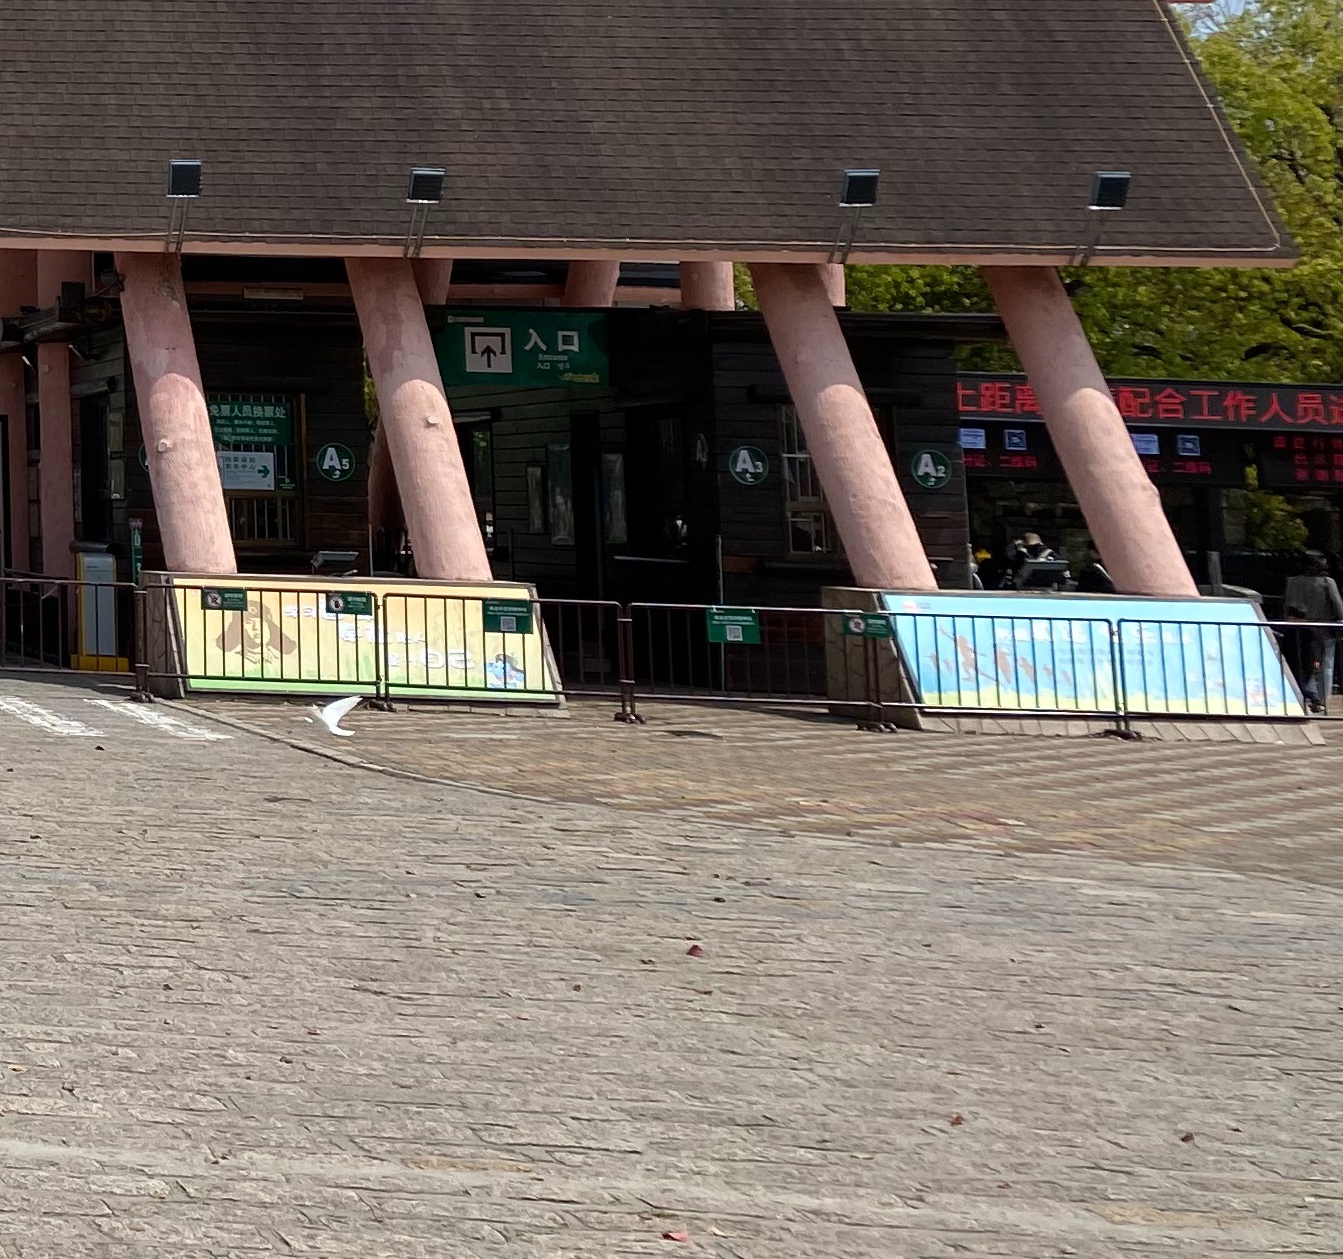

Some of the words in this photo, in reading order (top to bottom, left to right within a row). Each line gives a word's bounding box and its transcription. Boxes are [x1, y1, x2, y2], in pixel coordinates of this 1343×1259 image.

[524, 328, 579, 353] 入口
[323, 447, 350, 470] A5
[735, 449, 763, 473] A3
[917, 453, 946, 477] A2
